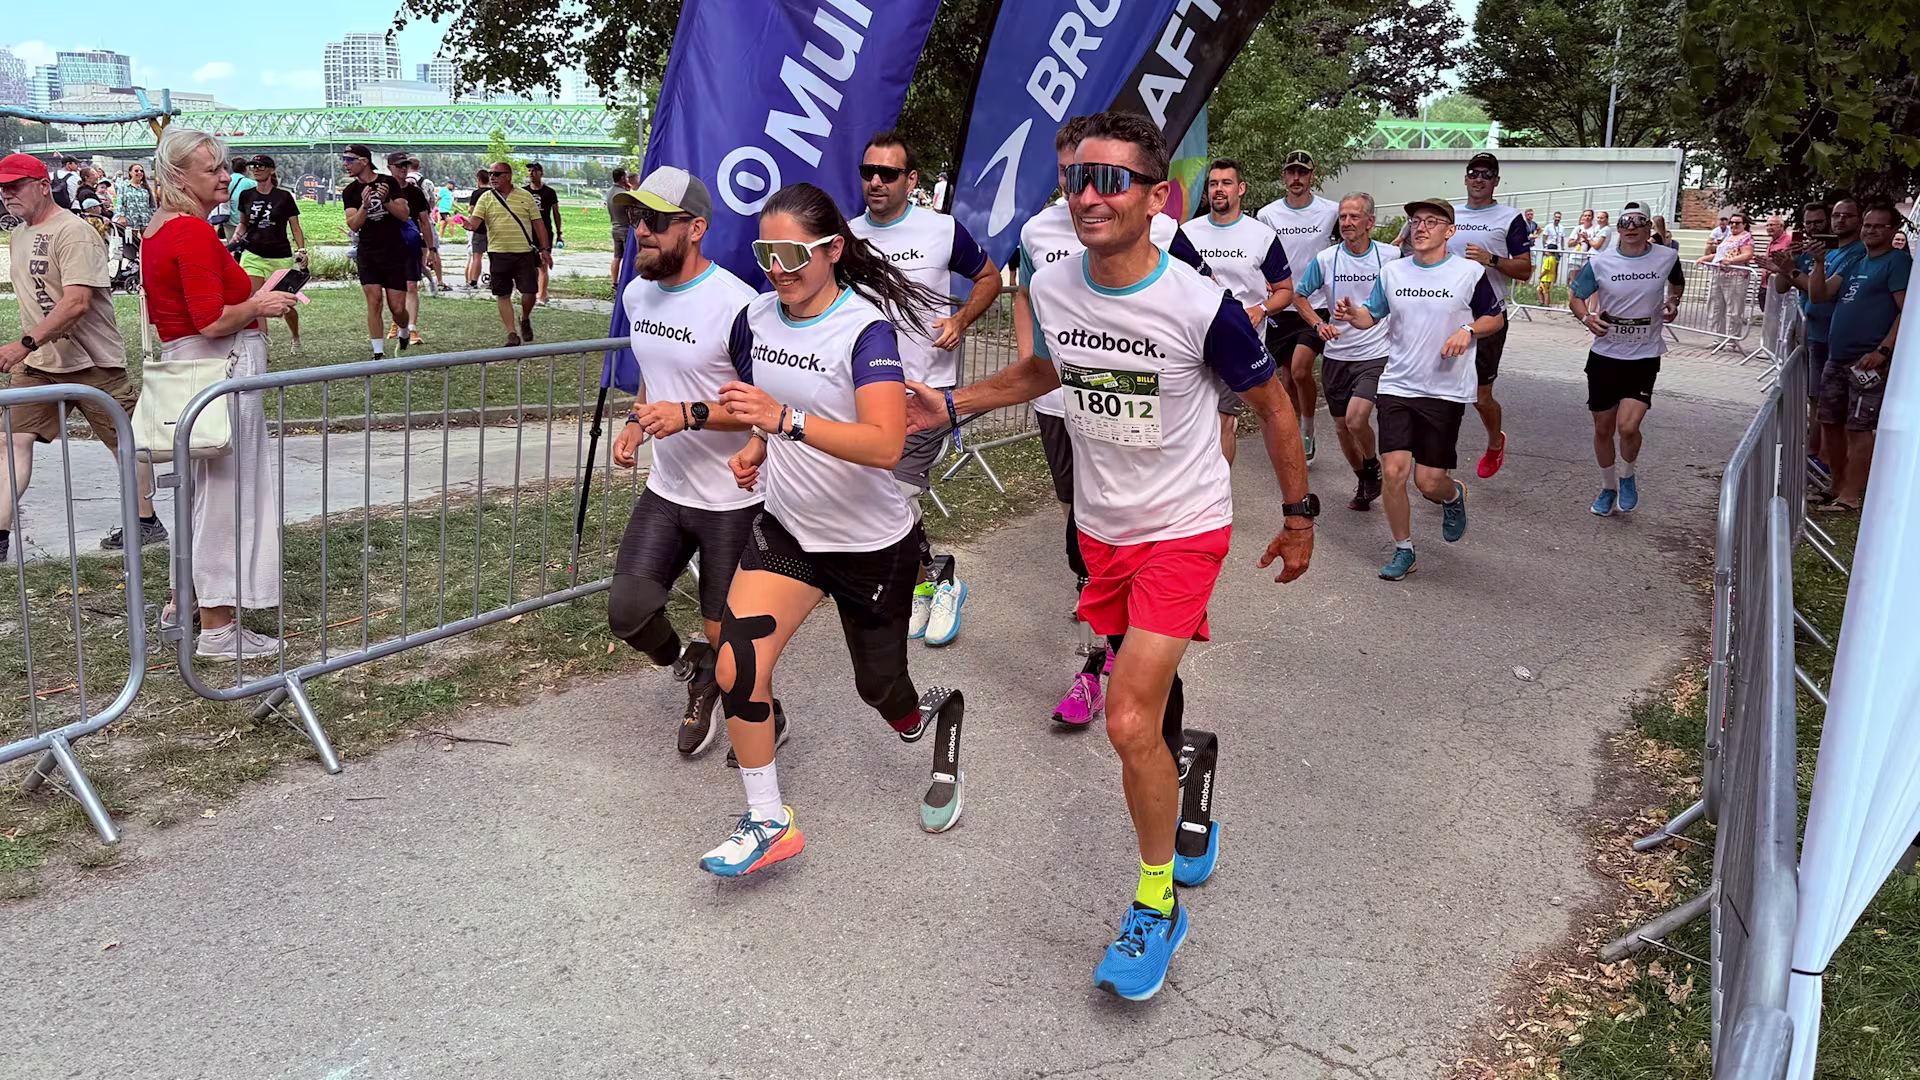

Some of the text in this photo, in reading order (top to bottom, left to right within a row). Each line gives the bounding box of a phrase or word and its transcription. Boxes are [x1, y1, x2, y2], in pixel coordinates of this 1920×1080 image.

[1276, 224, 1322, 235] ottobock.
[1610, 271, 1660, 282] ottobock.
[1395, 286, 1454, 299] ottobock.
[633, 318, 696, 345] ottobock.
[1057, 328, 1167, 359] ottobock.
[1614, 325, 1647, 335] 18011
[751, 344, 827, 373] ottobock.
[1073, 389, 1154, 419] 18012
[947, 723, 958, 763] ottobock.
[1200, 769, 1212, 812] ottobock.
